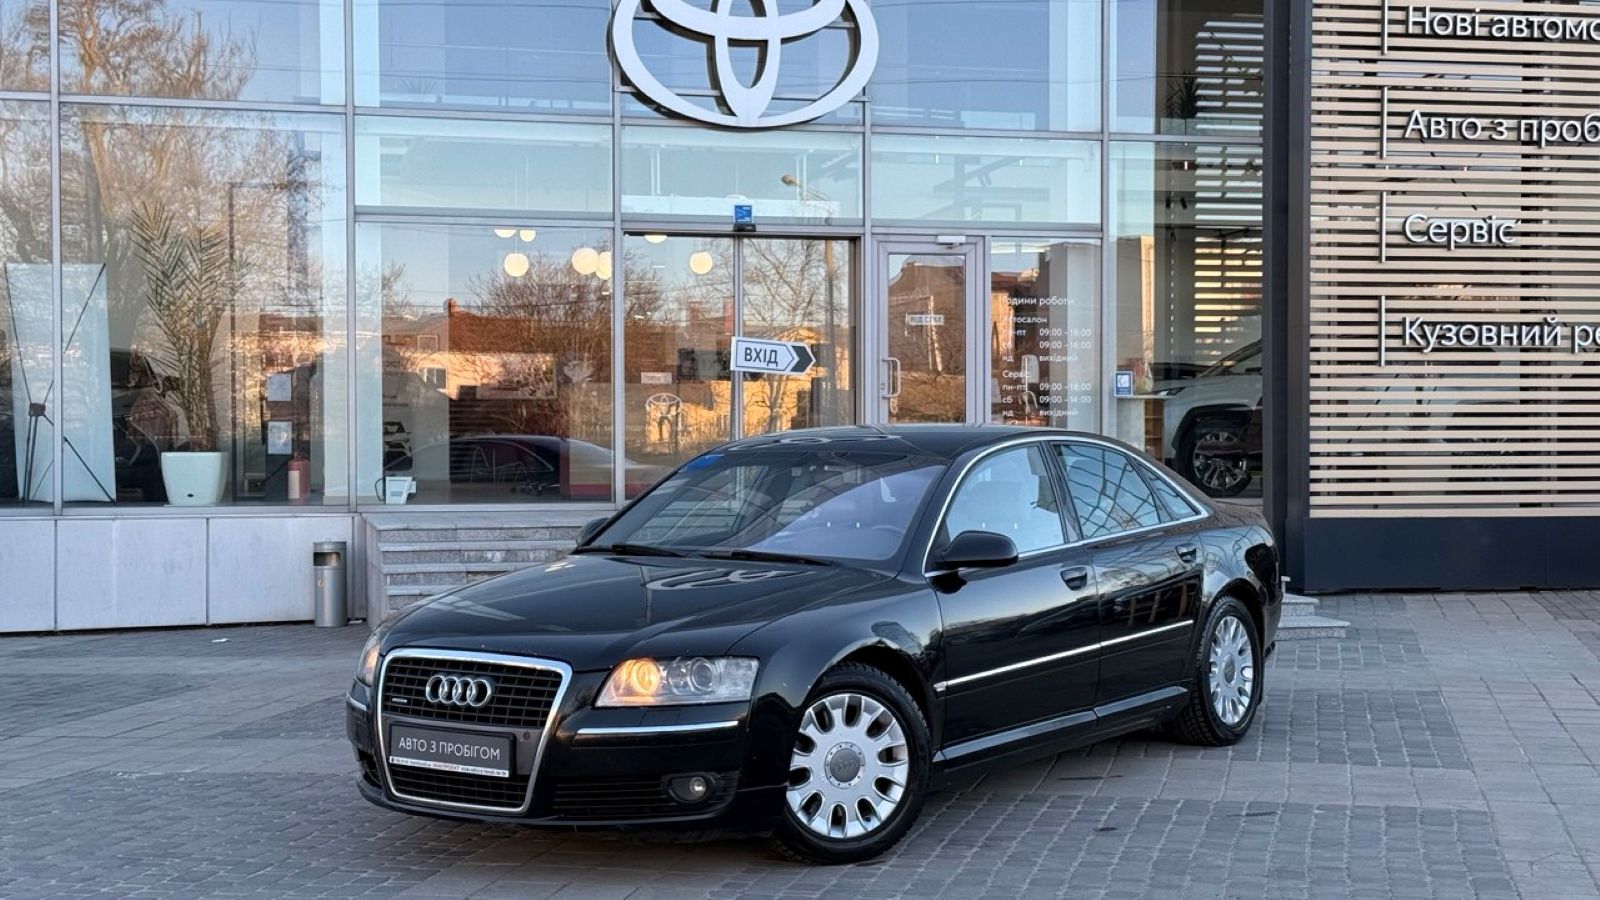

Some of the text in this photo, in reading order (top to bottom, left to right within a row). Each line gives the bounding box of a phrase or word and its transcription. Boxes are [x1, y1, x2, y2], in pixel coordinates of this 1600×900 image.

[1407, 4, 1600, 41] Нові автомо
[1404, 110, 1600, 149] Авто з проб
[1404, 214, 1517, 250] Сервіс
[1039, 296, 1074, 307] роботи
[1003, 316, 1048, 324] тосалон
[1039, 328, 1062, 337] 09:00
[1403, 315, 1600, 353] Кузовний р
[1039, 341, 1062, 349] 09:00
[744, 346, 779, 367] ВХІД
[1039, 383, 1062, 391] 09:00
[1002, 395, 1013, 403] сб
[1039, 395, 1062, 404] 09:00
[1070, 395, 1092, 403] 14:00
[1039, 408, 1078, 417] вихідний
[399, 737, 427, 752] АВТО
[440, 741, 501, 761] ПРОБІГОМ
